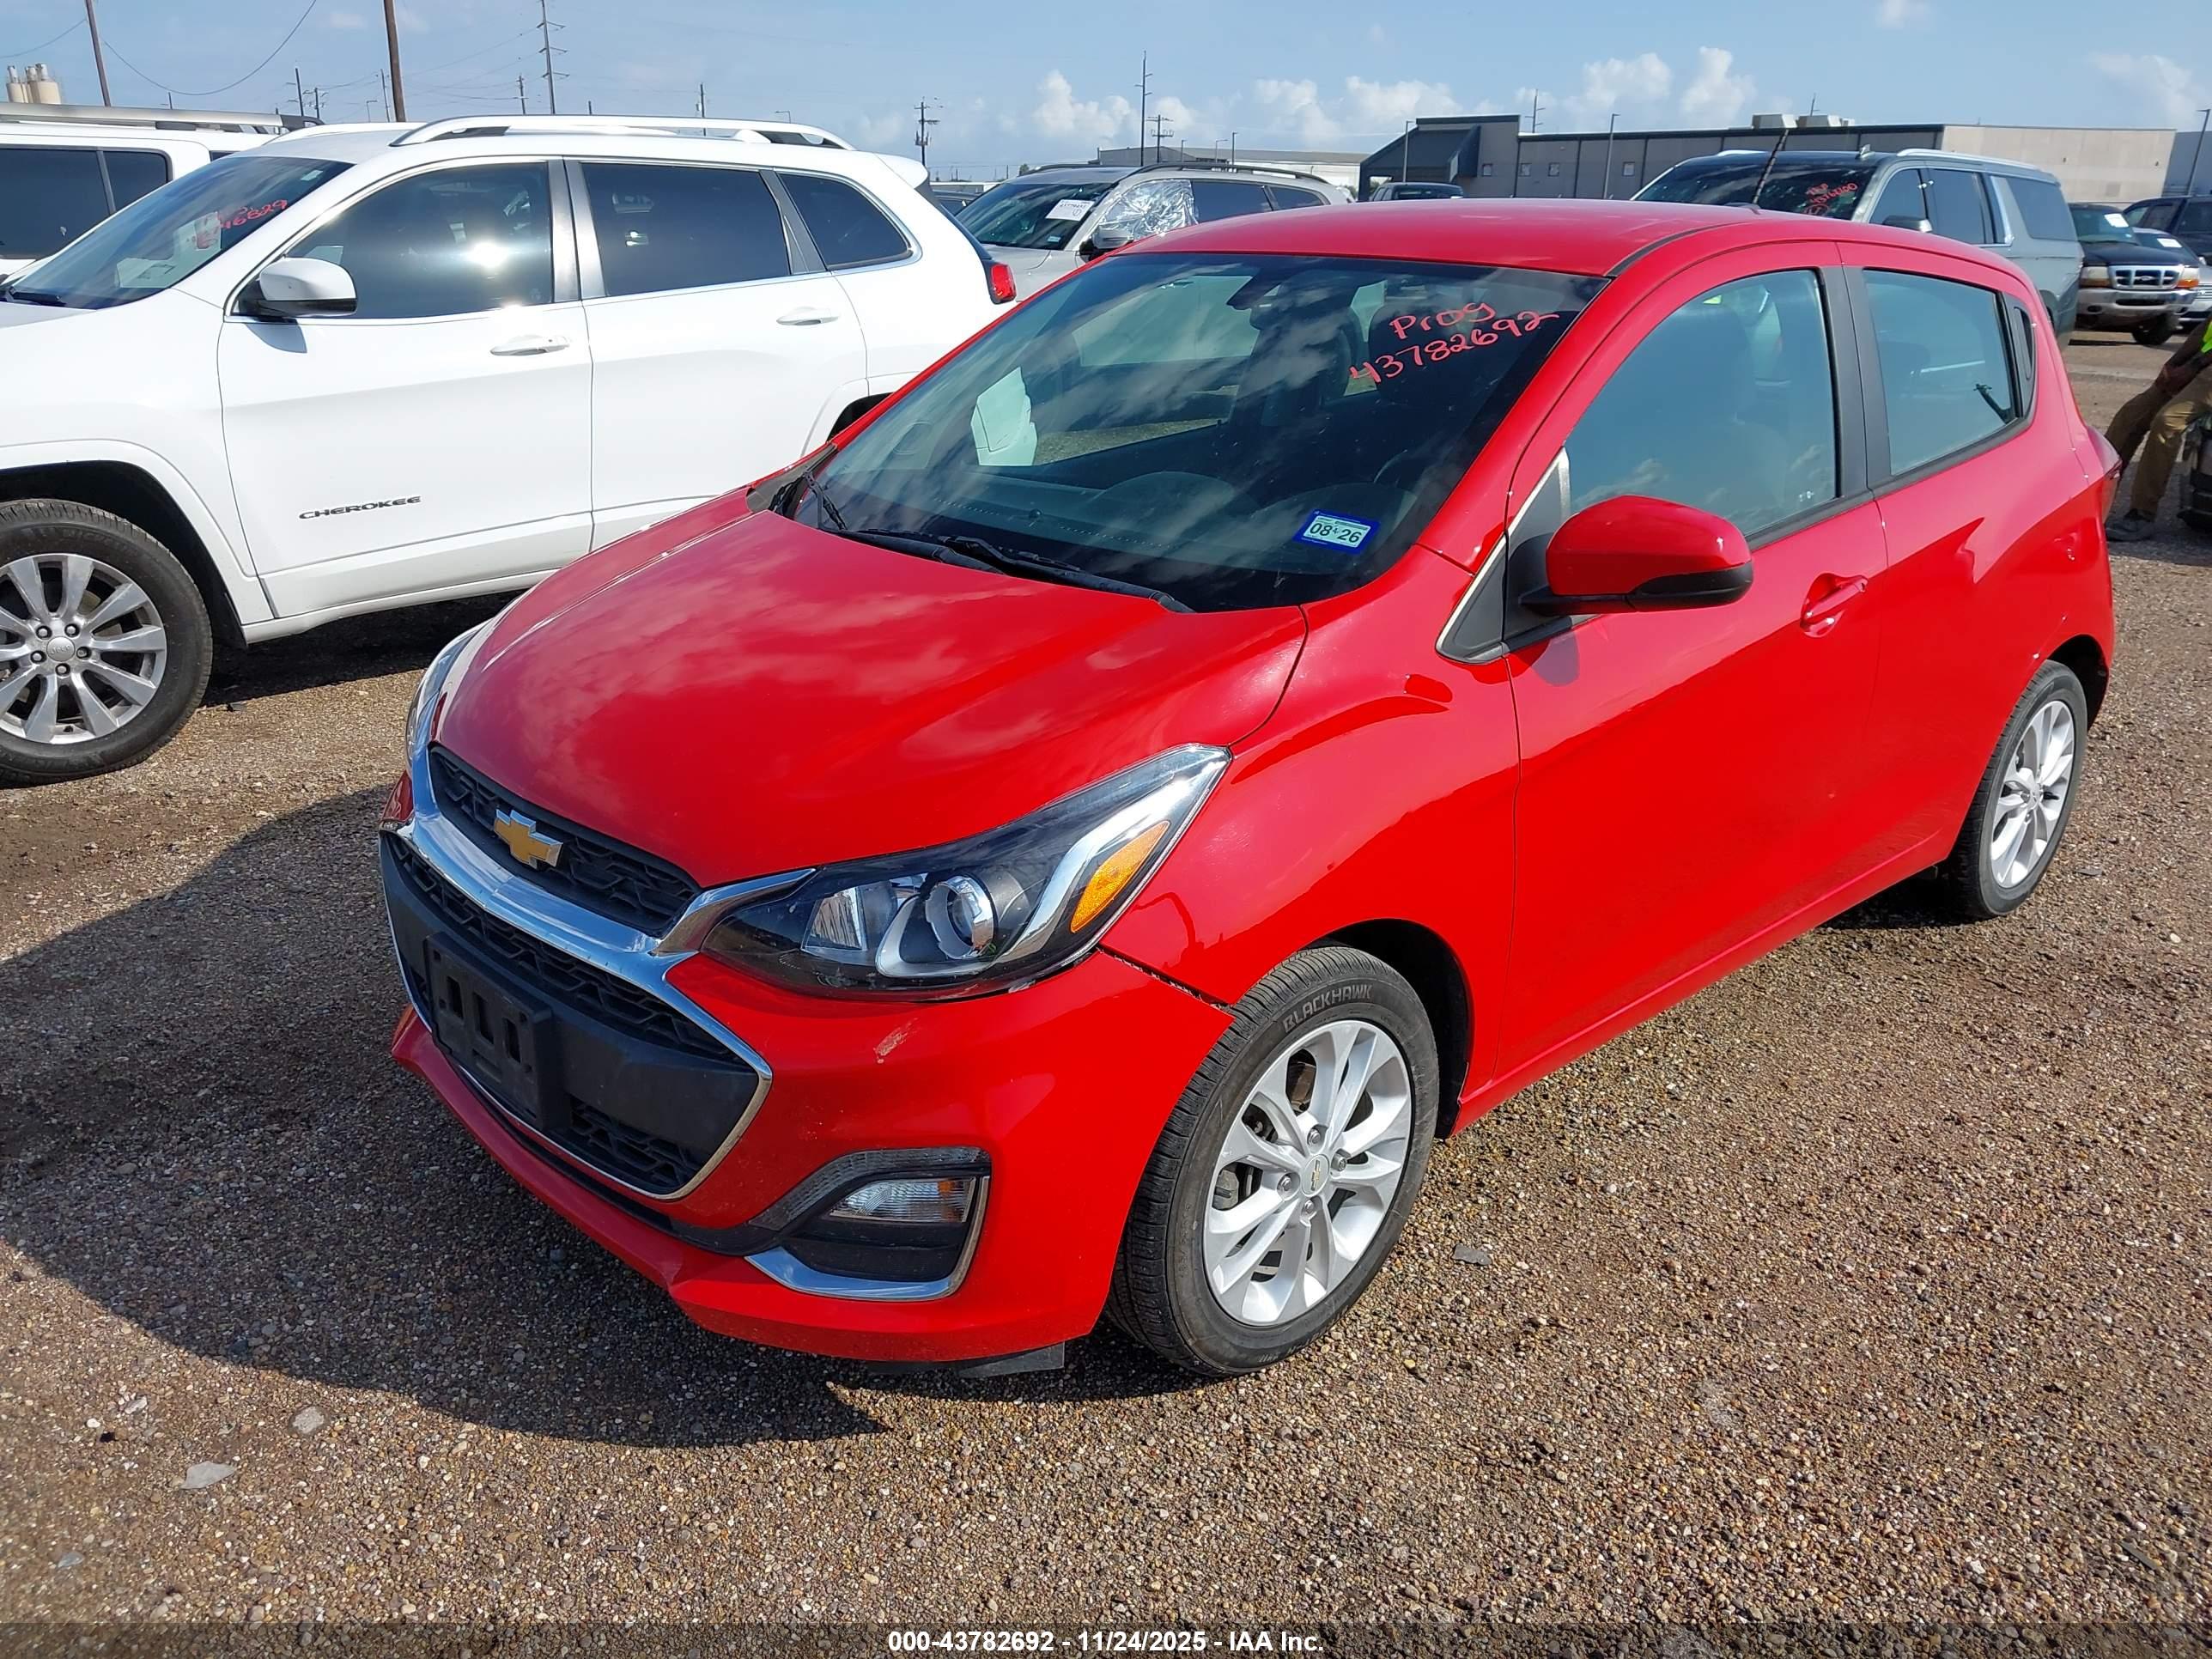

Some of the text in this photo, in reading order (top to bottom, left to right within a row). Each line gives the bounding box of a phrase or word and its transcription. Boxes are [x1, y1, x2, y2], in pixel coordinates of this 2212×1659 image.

[1389, 302, 1497, 340] Prog
[1349, 310, 1560, 384] 43782692
[299, 495, 421, 520] CHEROKEE
[1310, 523, 1334, 537] 08
[1337, 528, 1362, 544] 26
[1283, 984, 1372, 1033] BLACKHAWK
